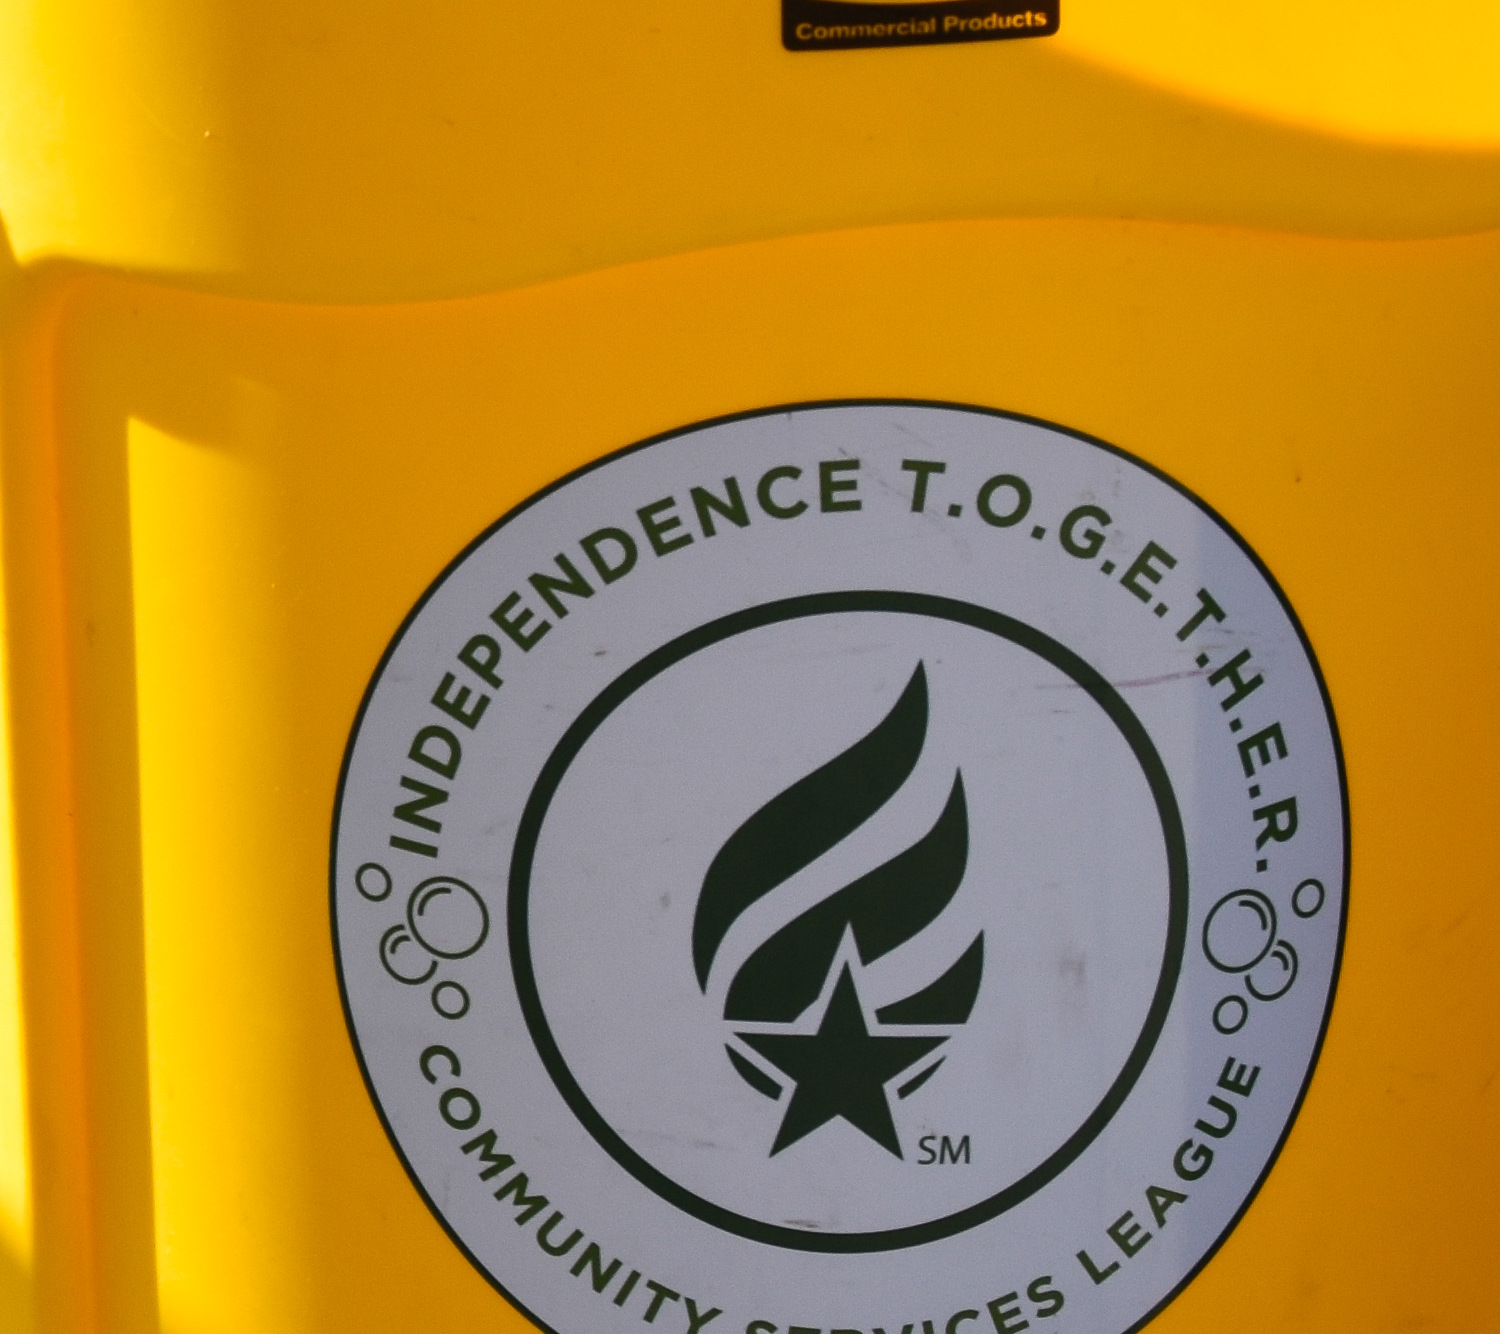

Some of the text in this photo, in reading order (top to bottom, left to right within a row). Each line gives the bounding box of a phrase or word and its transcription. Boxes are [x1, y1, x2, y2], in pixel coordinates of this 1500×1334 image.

[795, 10, 1048, 41] Commercial Products
[389, 458, 1299, 873] INDEPENDENCE T.O.G.E.T.H.E.R.
[918, 1135, 973, 1167] SM
[1075, 1054, 1261, 1284] LEAGUE
